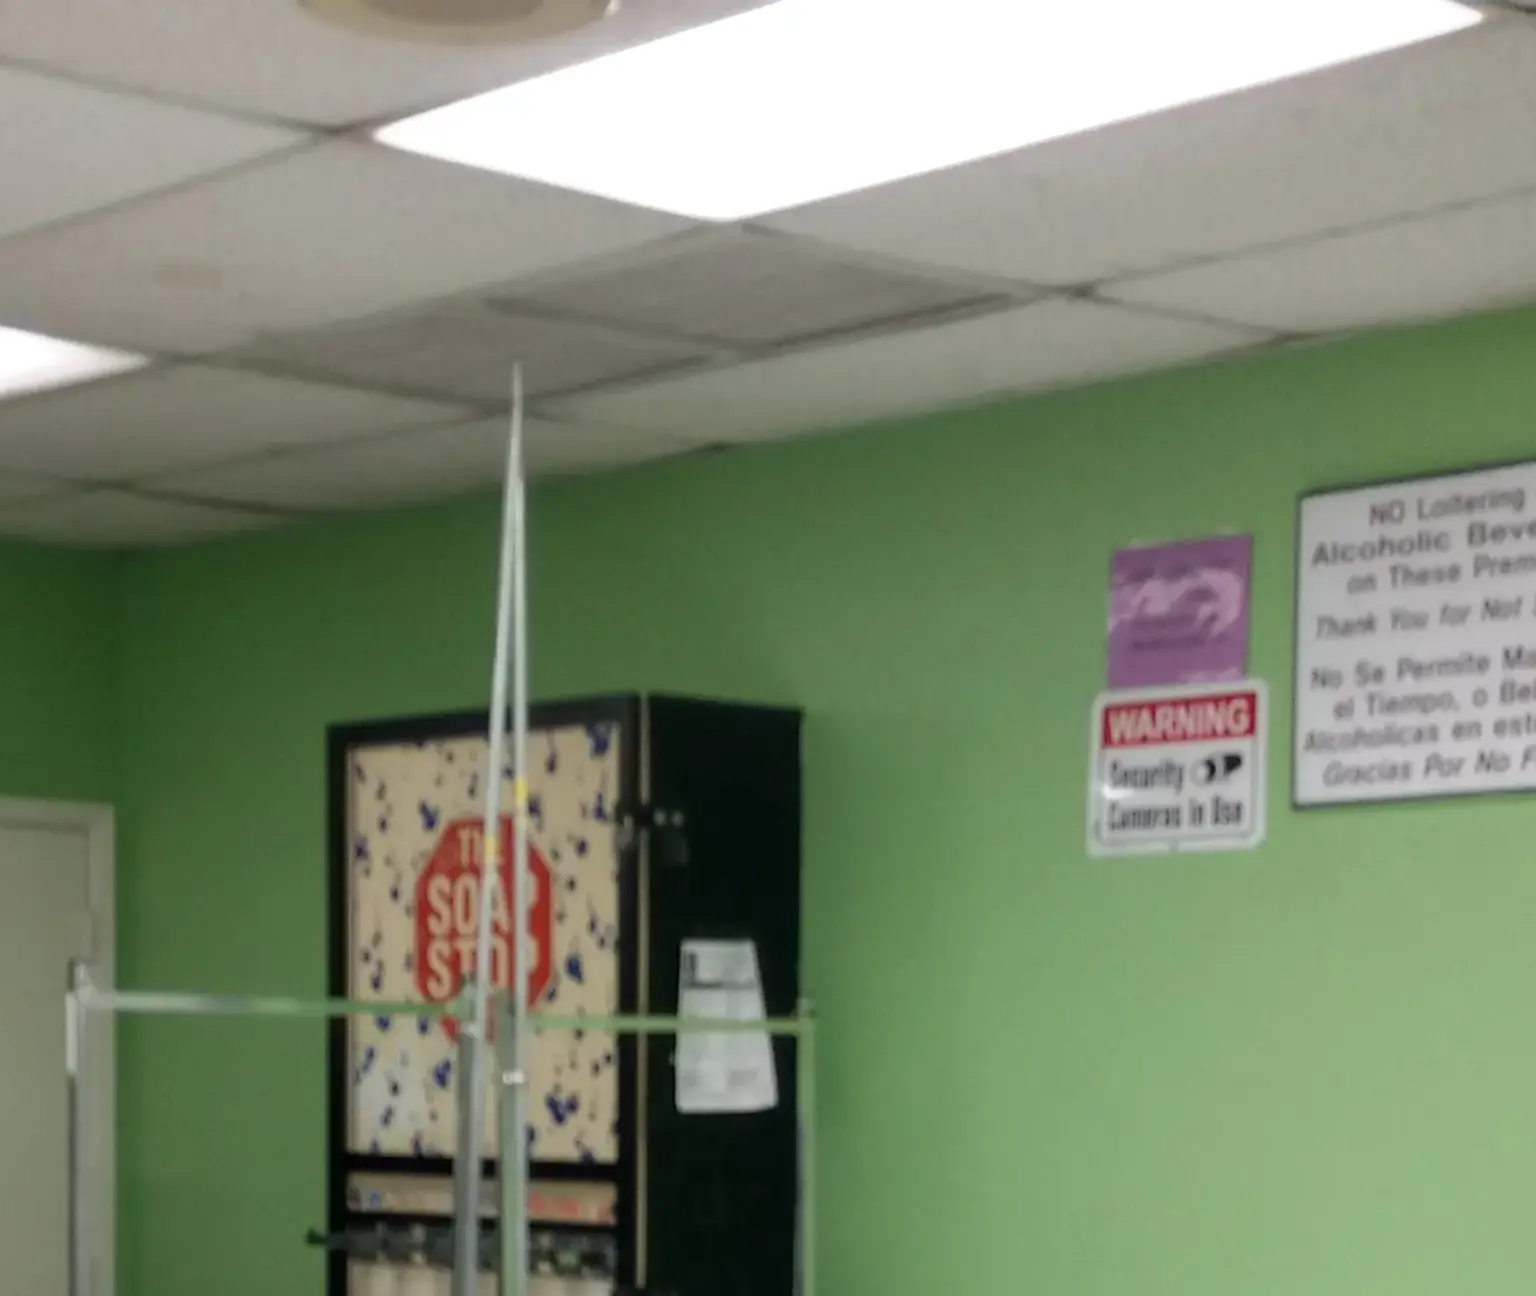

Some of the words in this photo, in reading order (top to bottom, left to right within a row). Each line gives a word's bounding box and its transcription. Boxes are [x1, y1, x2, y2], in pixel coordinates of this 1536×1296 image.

[1368, 499, 1406, 526] NO
[1417, 487, 1525, 520] Loitering
[1311, 531, 1450, 568] Alcoholic
[1346, 573, 1378, 595] on
[1390, 561, 1462, 589] These
[1314, 613, 1377, 640] Thank
[1390, 606, 1430, 631] You
[1440, 603, 1471, 627] for
[1480, 596, 1523, 621] Not
[1310, 666, 1344, 691] No
[1354, 658, 1386, 686] Se
[1396, 649, 1491, 681] Permite
[1107, 699, 1250, 745] WARNING
[1333, 696, 1355, 722] el
[1471, 687, 1490, 709] o
[1303, 722, 1439, 752] Alcoholicas
[1451, 720, 1482, 742] en
[1109, 758, 1183, 794] Security
[1322, 760, 1412, 788] Gracias
[1423, 752, 1466, 778] Por
[1474, 748, 1511, 775] No
[1107, 800, 1181, 832] Cameras
[1188, 798, 1204, 826] in
[1211, 795, 1243, 825] Use
[456, 827, 507, 867] TH
